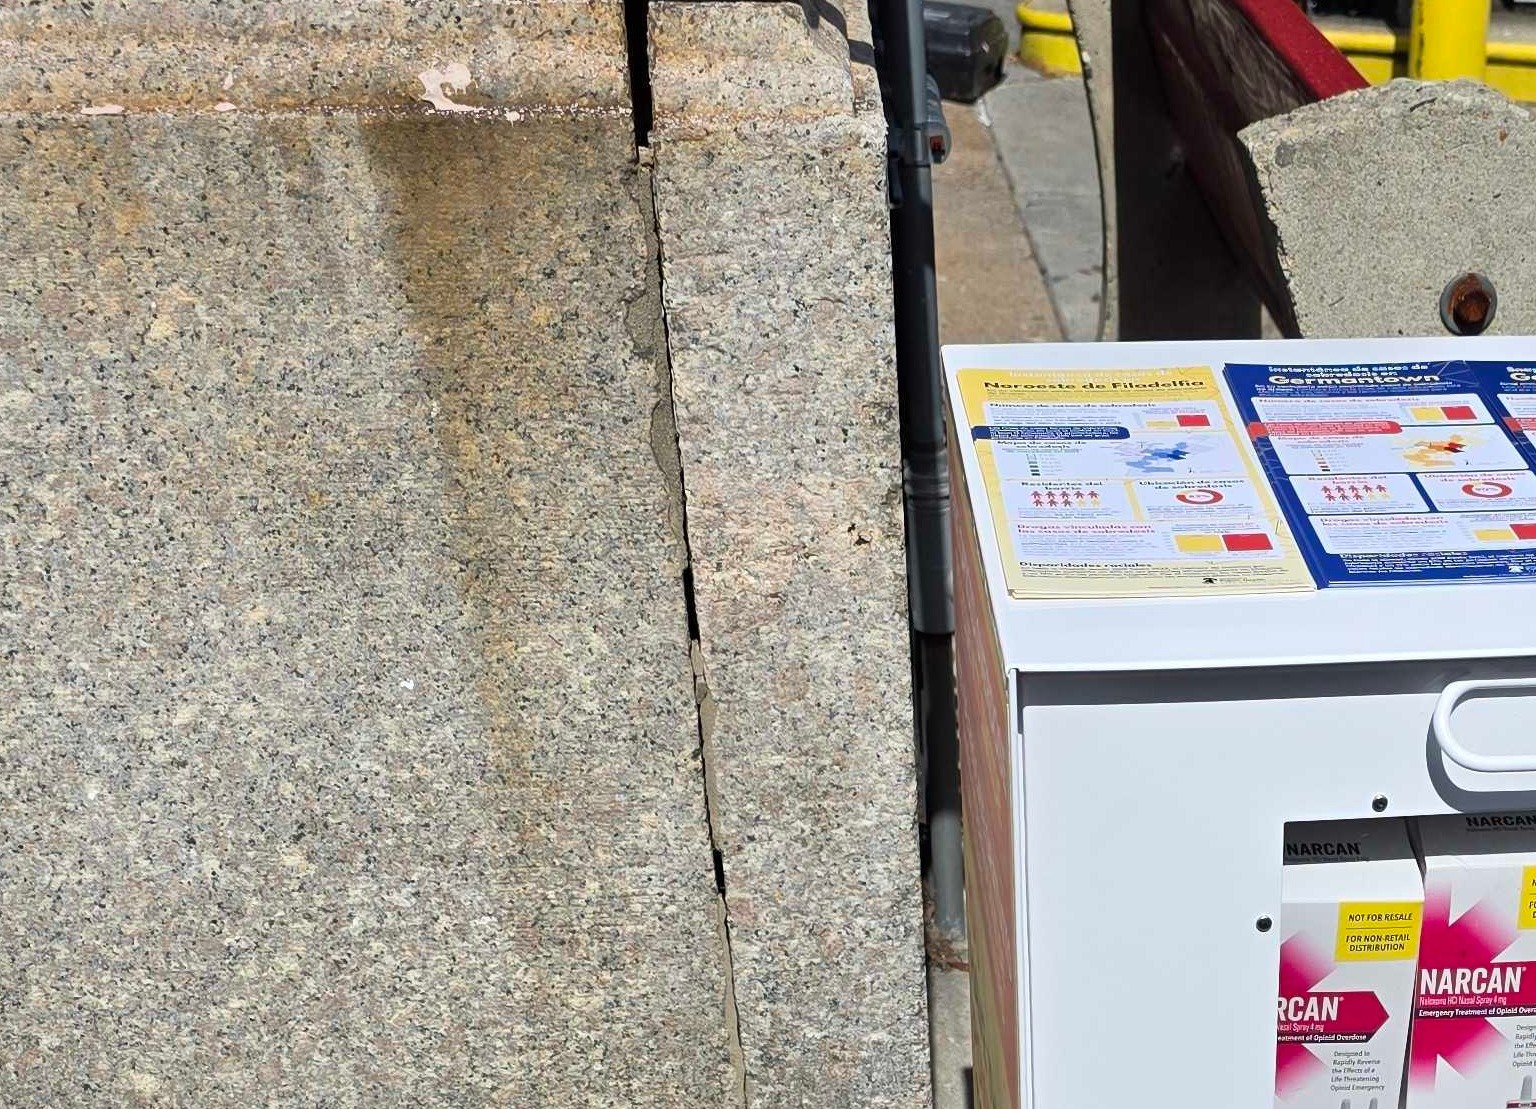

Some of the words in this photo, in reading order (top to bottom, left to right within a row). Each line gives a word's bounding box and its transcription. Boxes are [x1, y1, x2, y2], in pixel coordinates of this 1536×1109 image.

[984, 381, 1076, 390] Noroeste
[1111, 380, 1205, 389] Filadelfia
[1268, 375, 1440, 385] Germantown
[1286, 842, 1361, 857] NARCAN
[1348, 914, 1366, 922] NOT
[1367, 913, 1384, 921] FOR
[1385, 913, 1413, 921] RESALE
[1346, 935, 1362, 943] FOR
[1364, 934, 1410, 942] NON-RETAIL
[1350, 944, 1405, 952] DISTRIBUTION
[1420, 967, 1523, 995] NARCAN
[1419, 1009, 1454, 1018] Emergency
[1456, 1008, 1487, 1016] Treatment
[1497, 1007, 1517, 1015] Opioid
